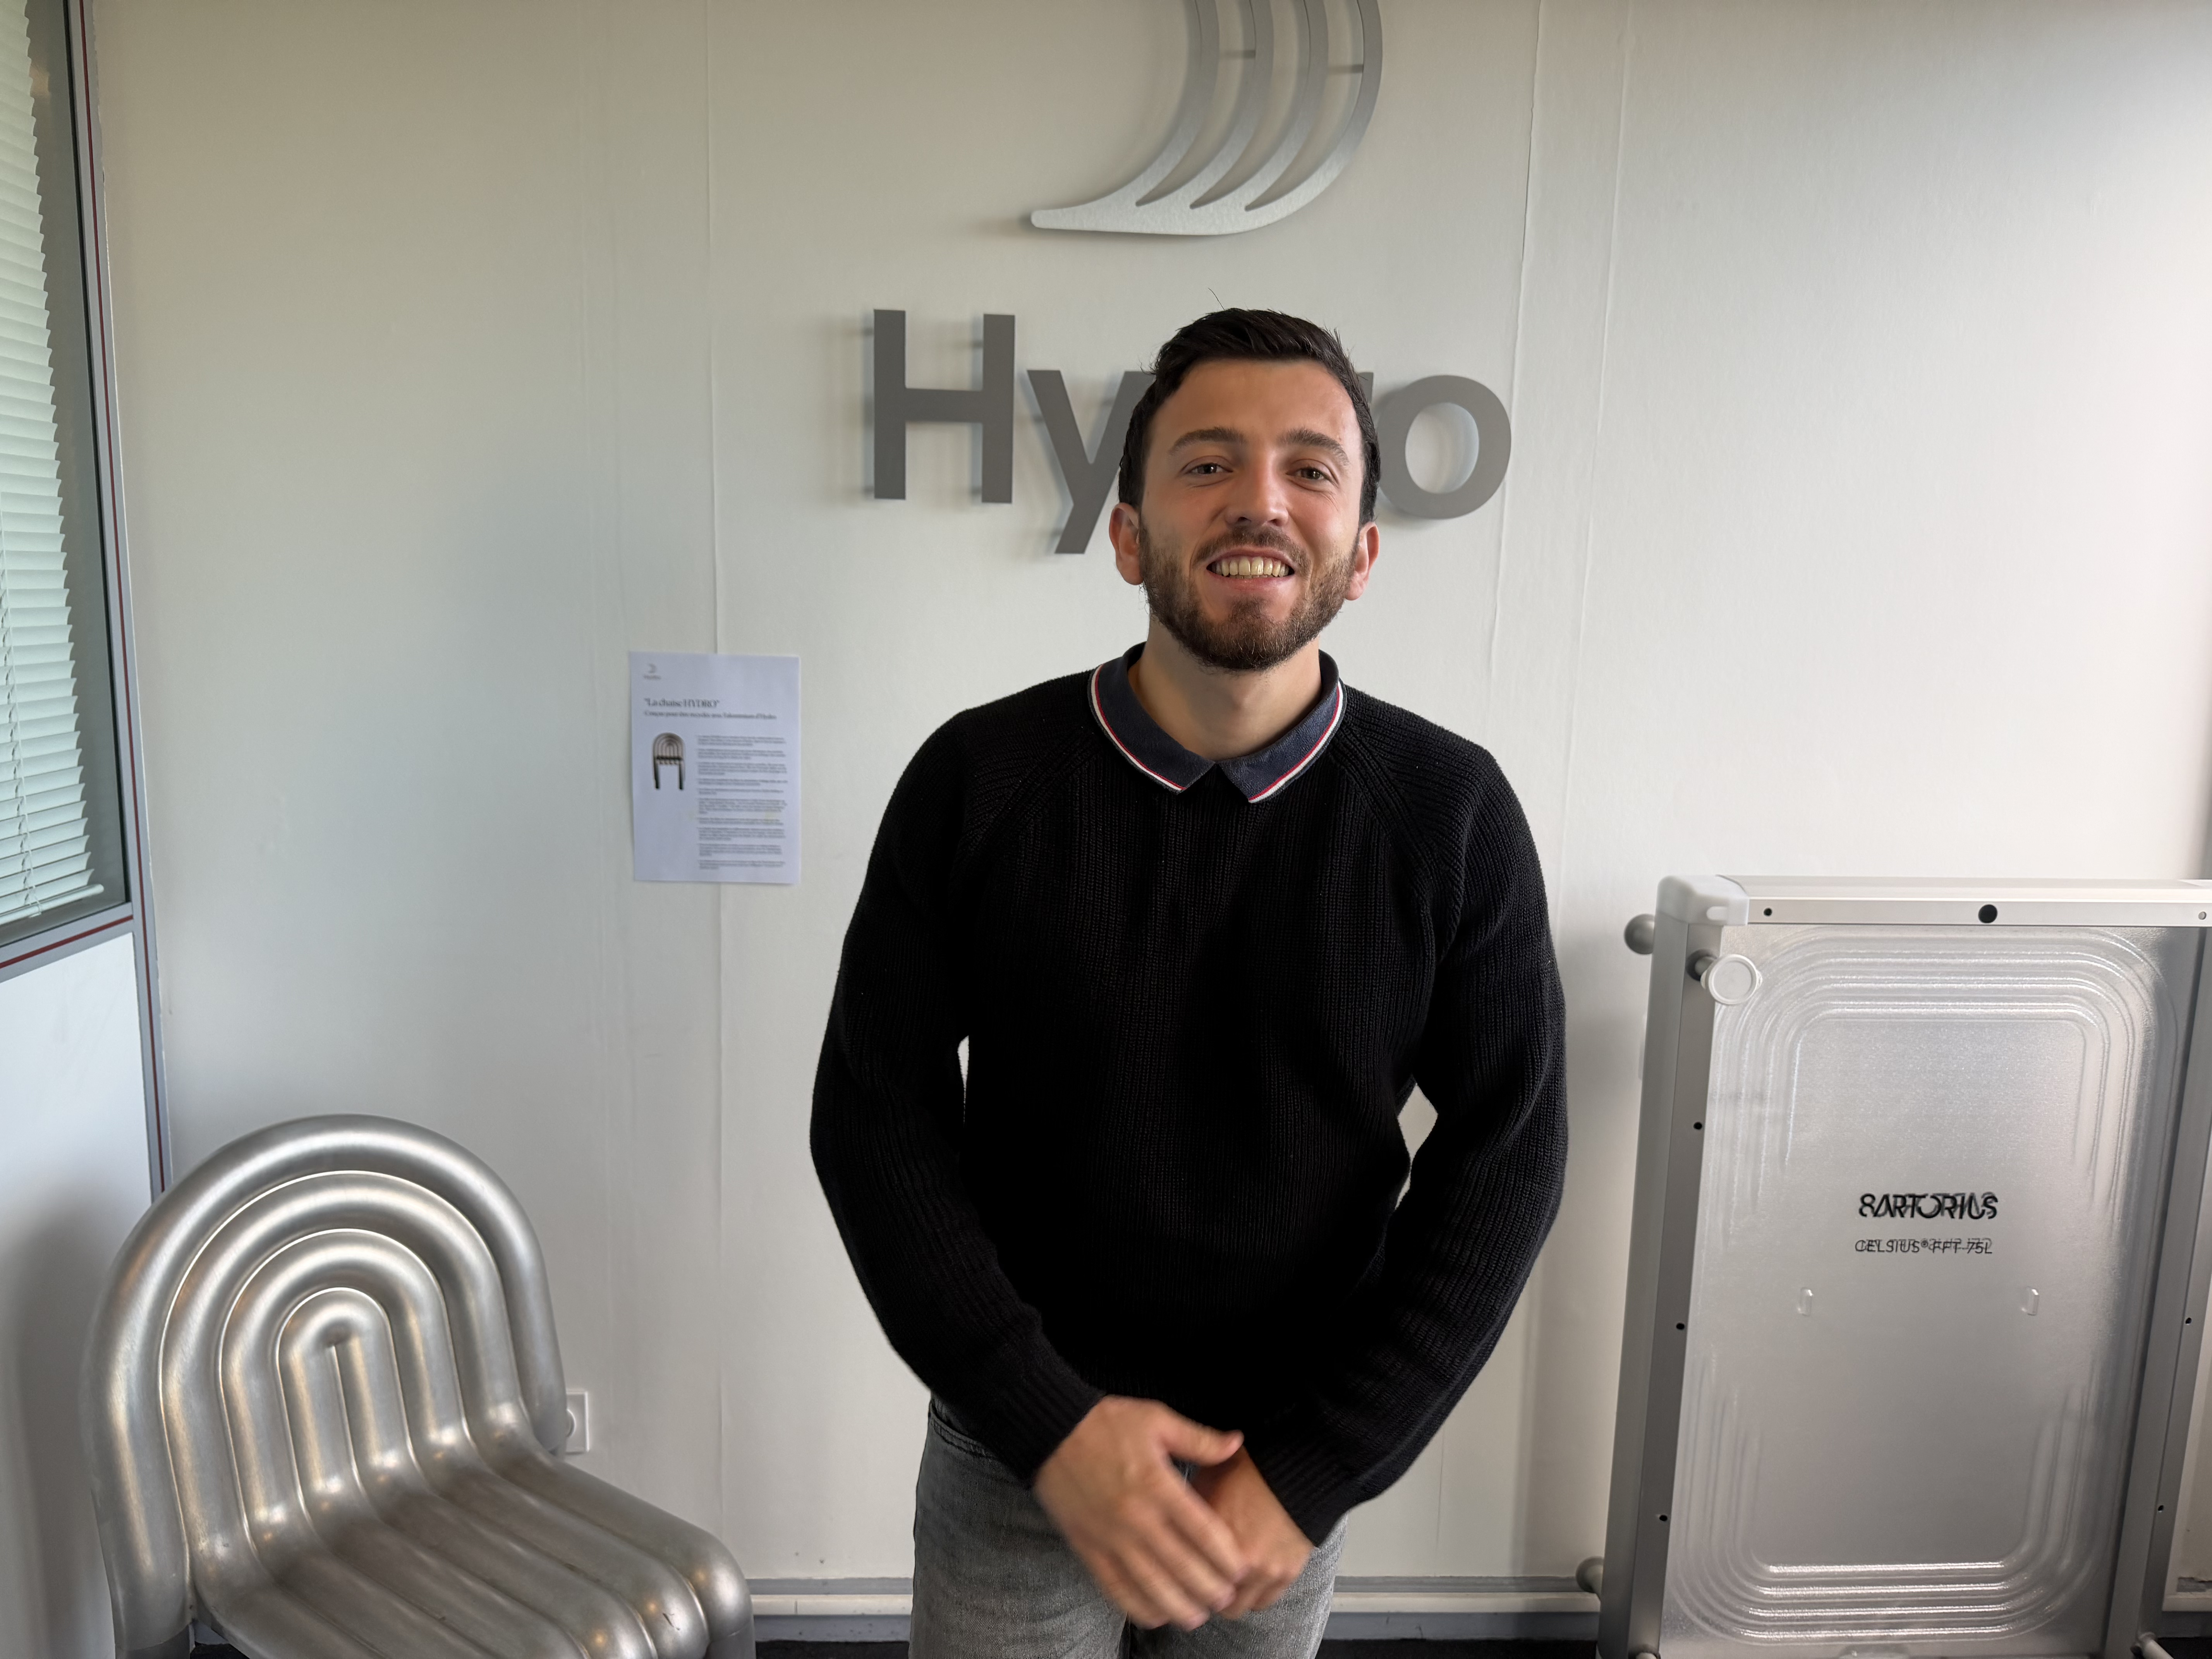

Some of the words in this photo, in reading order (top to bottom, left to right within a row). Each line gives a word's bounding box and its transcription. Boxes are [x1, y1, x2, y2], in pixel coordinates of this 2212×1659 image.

[874, 309, 1511, 554] Hyo
[659, 697, 682, 707] chaise
[1859, 1192, 1999, 1219] SARTORIUS
[1932, 1240, 1962, 1254] FFT
[1967, 1241, 1992, 1254] 75L
